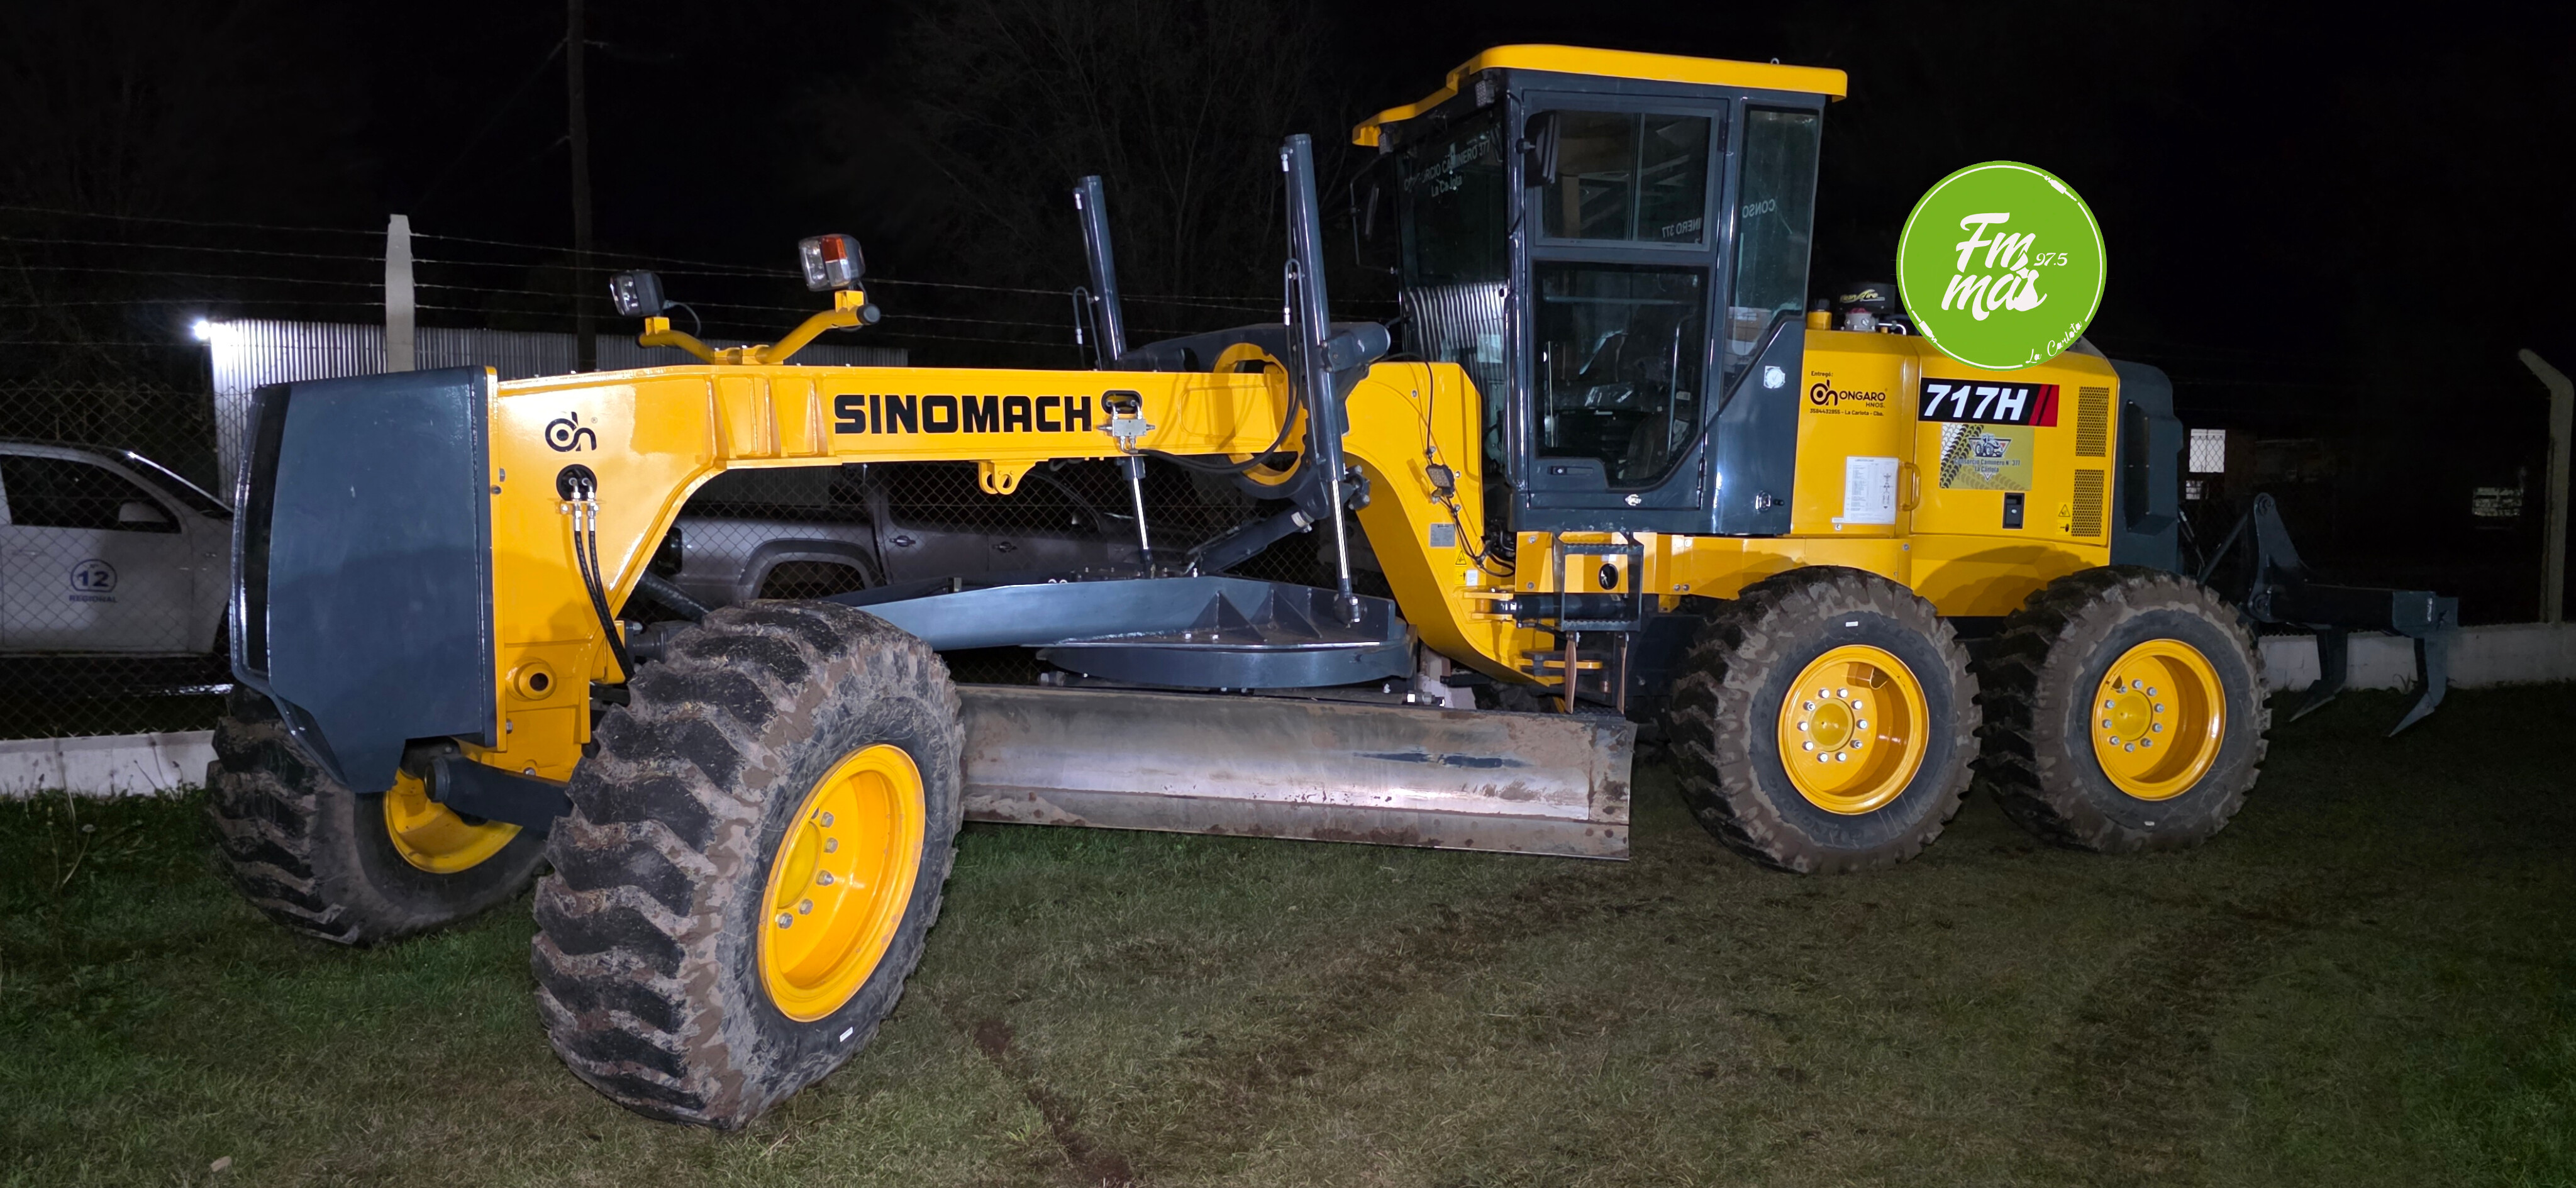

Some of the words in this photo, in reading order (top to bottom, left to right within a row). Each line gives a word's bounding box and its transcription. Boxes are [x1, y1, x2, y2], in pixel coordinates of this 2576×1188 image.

[1442, 145, 1477, 174] CAINERO
[1479, 139, 1490, 157] 377
[1431, 185, 1439, 197] La
[1440, 175, 1462, 193] Calota
[1839, 391, 1885, 401] ONGARO
[1924, 384, 2028, 421] 717H
[835, 394, 1092, 434] SINOMACH
[77, 570, 109, 587] 12
[69, 594, 118, 603] REGIONAL
